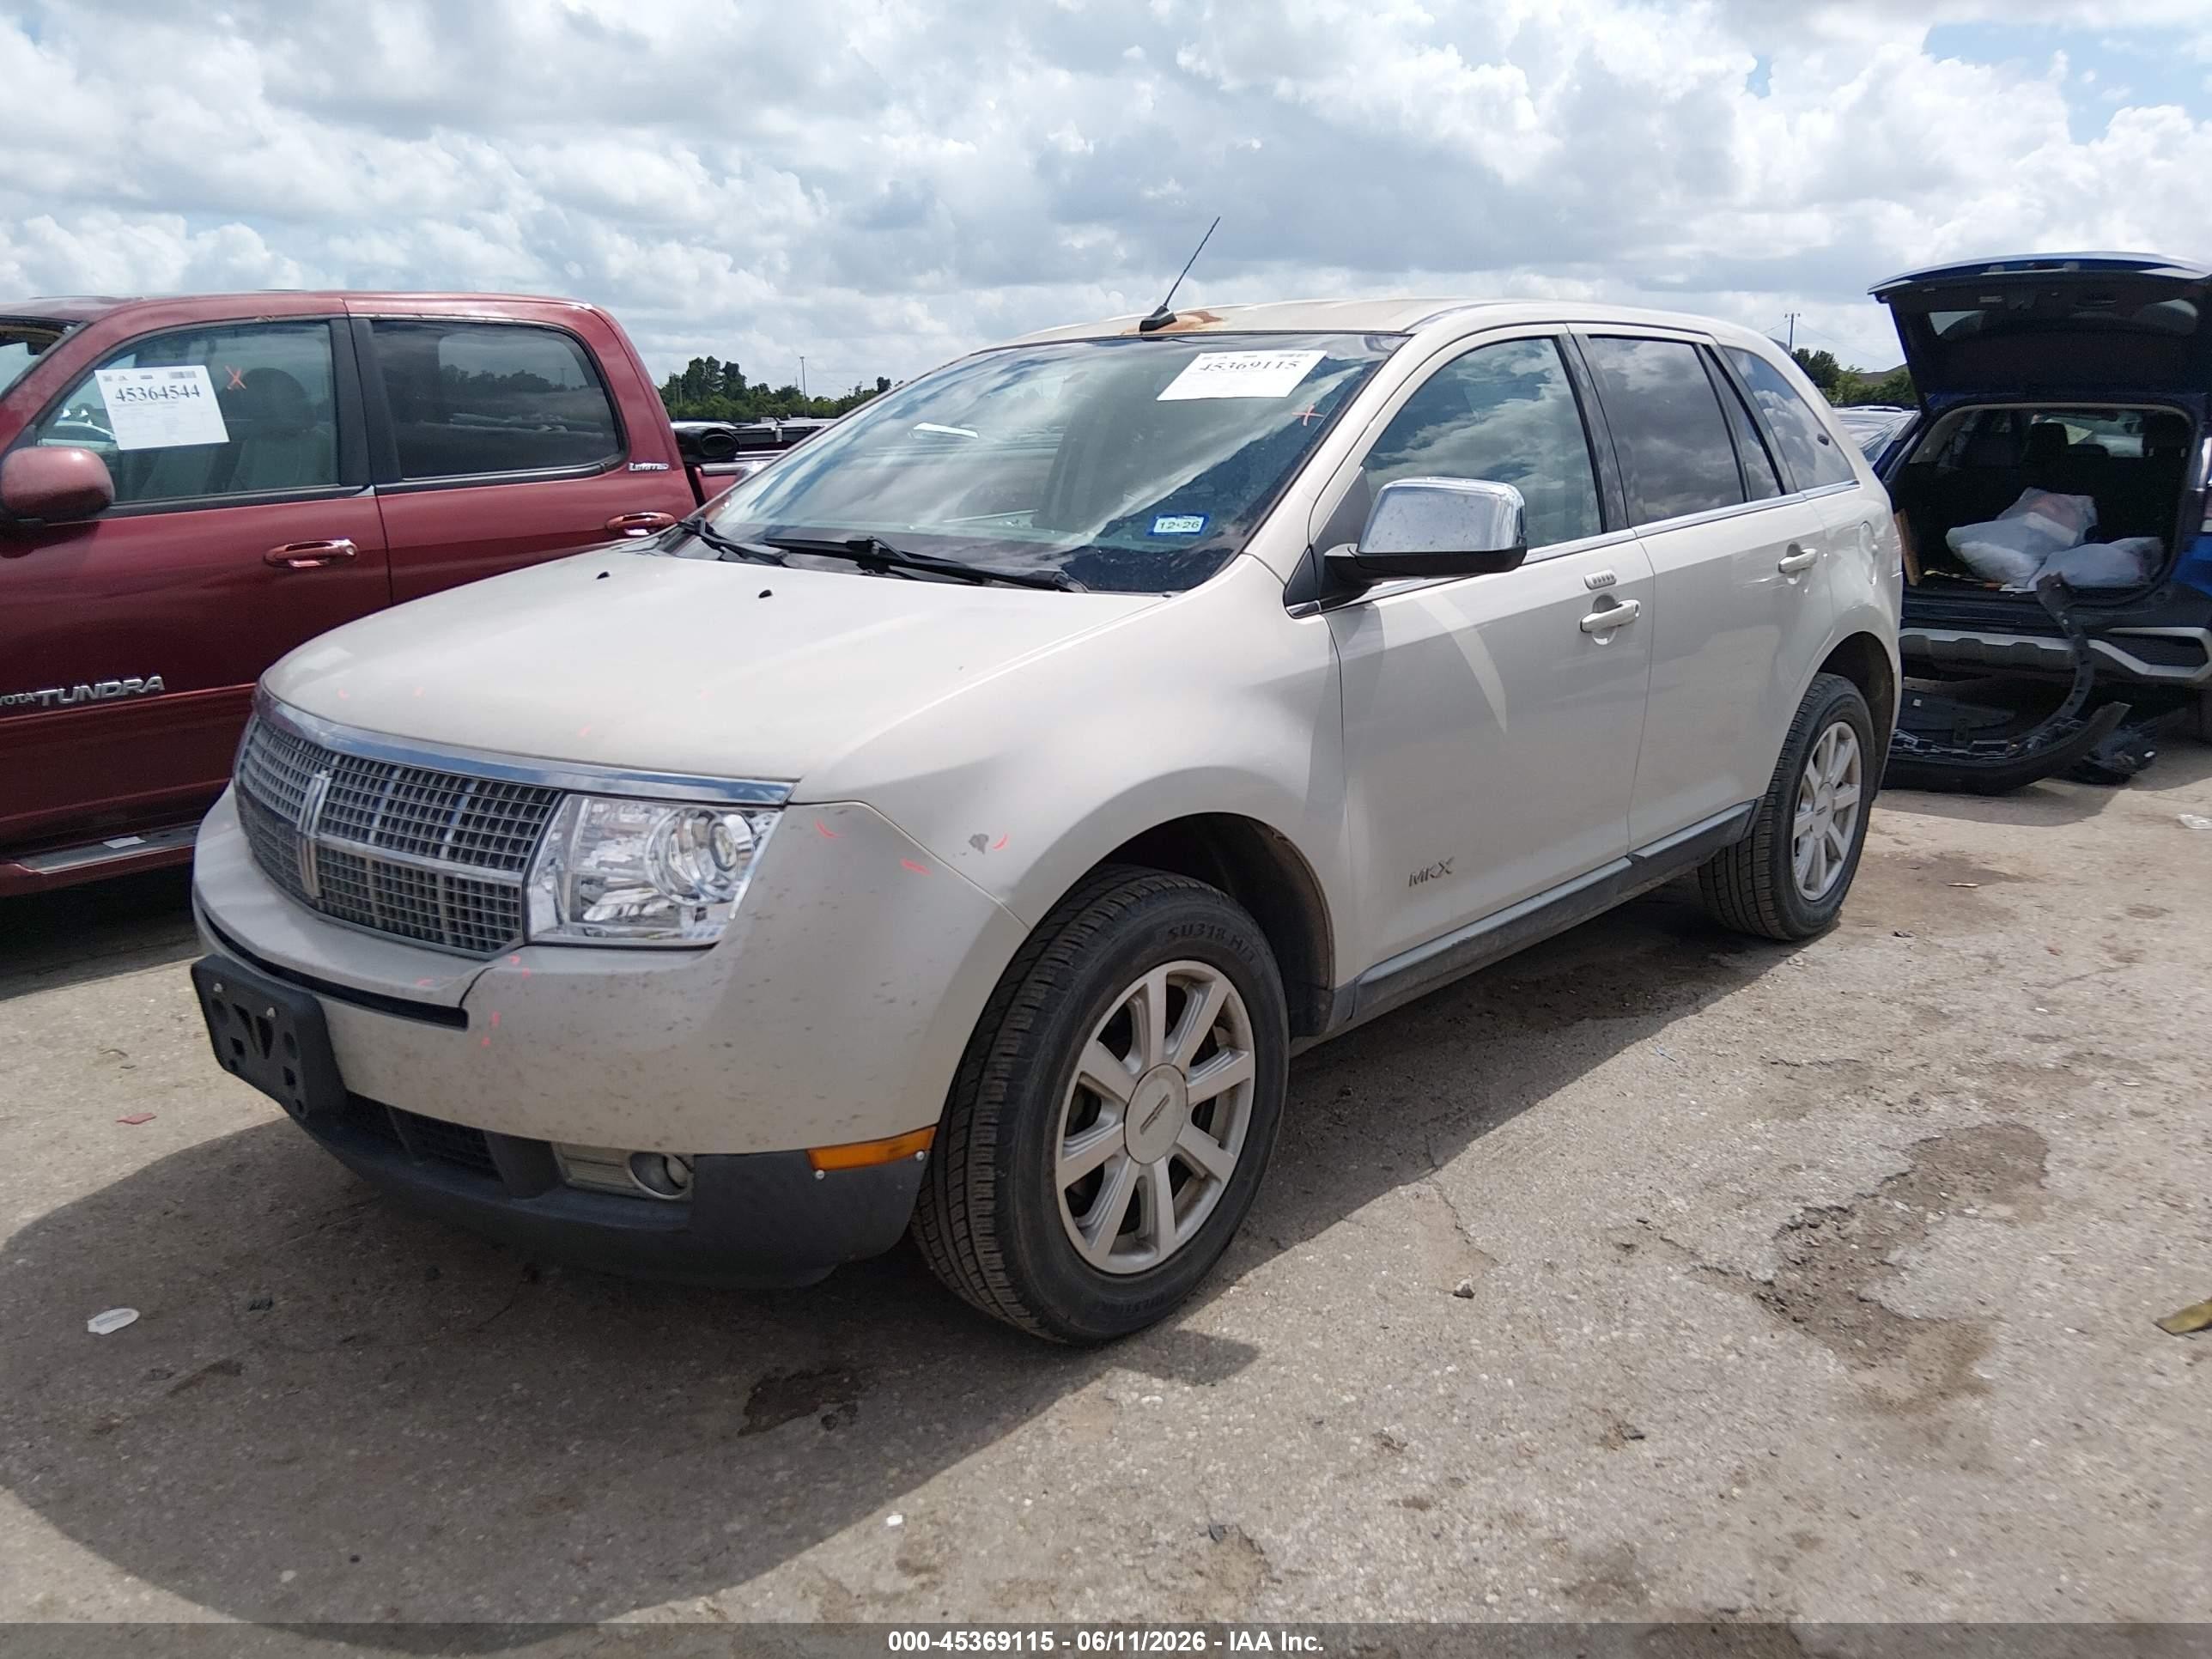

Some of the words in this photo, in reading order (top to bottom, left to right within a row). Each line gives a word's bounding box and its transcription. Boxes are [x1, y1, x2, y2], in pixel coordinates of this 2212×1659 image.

[114, 383, 201, 403] 45364544
[34, 676, 166, 707] TUNDRA
[1408, 856, 1455, 887] MKX
[1167, 922, 1227, 940] SU318
